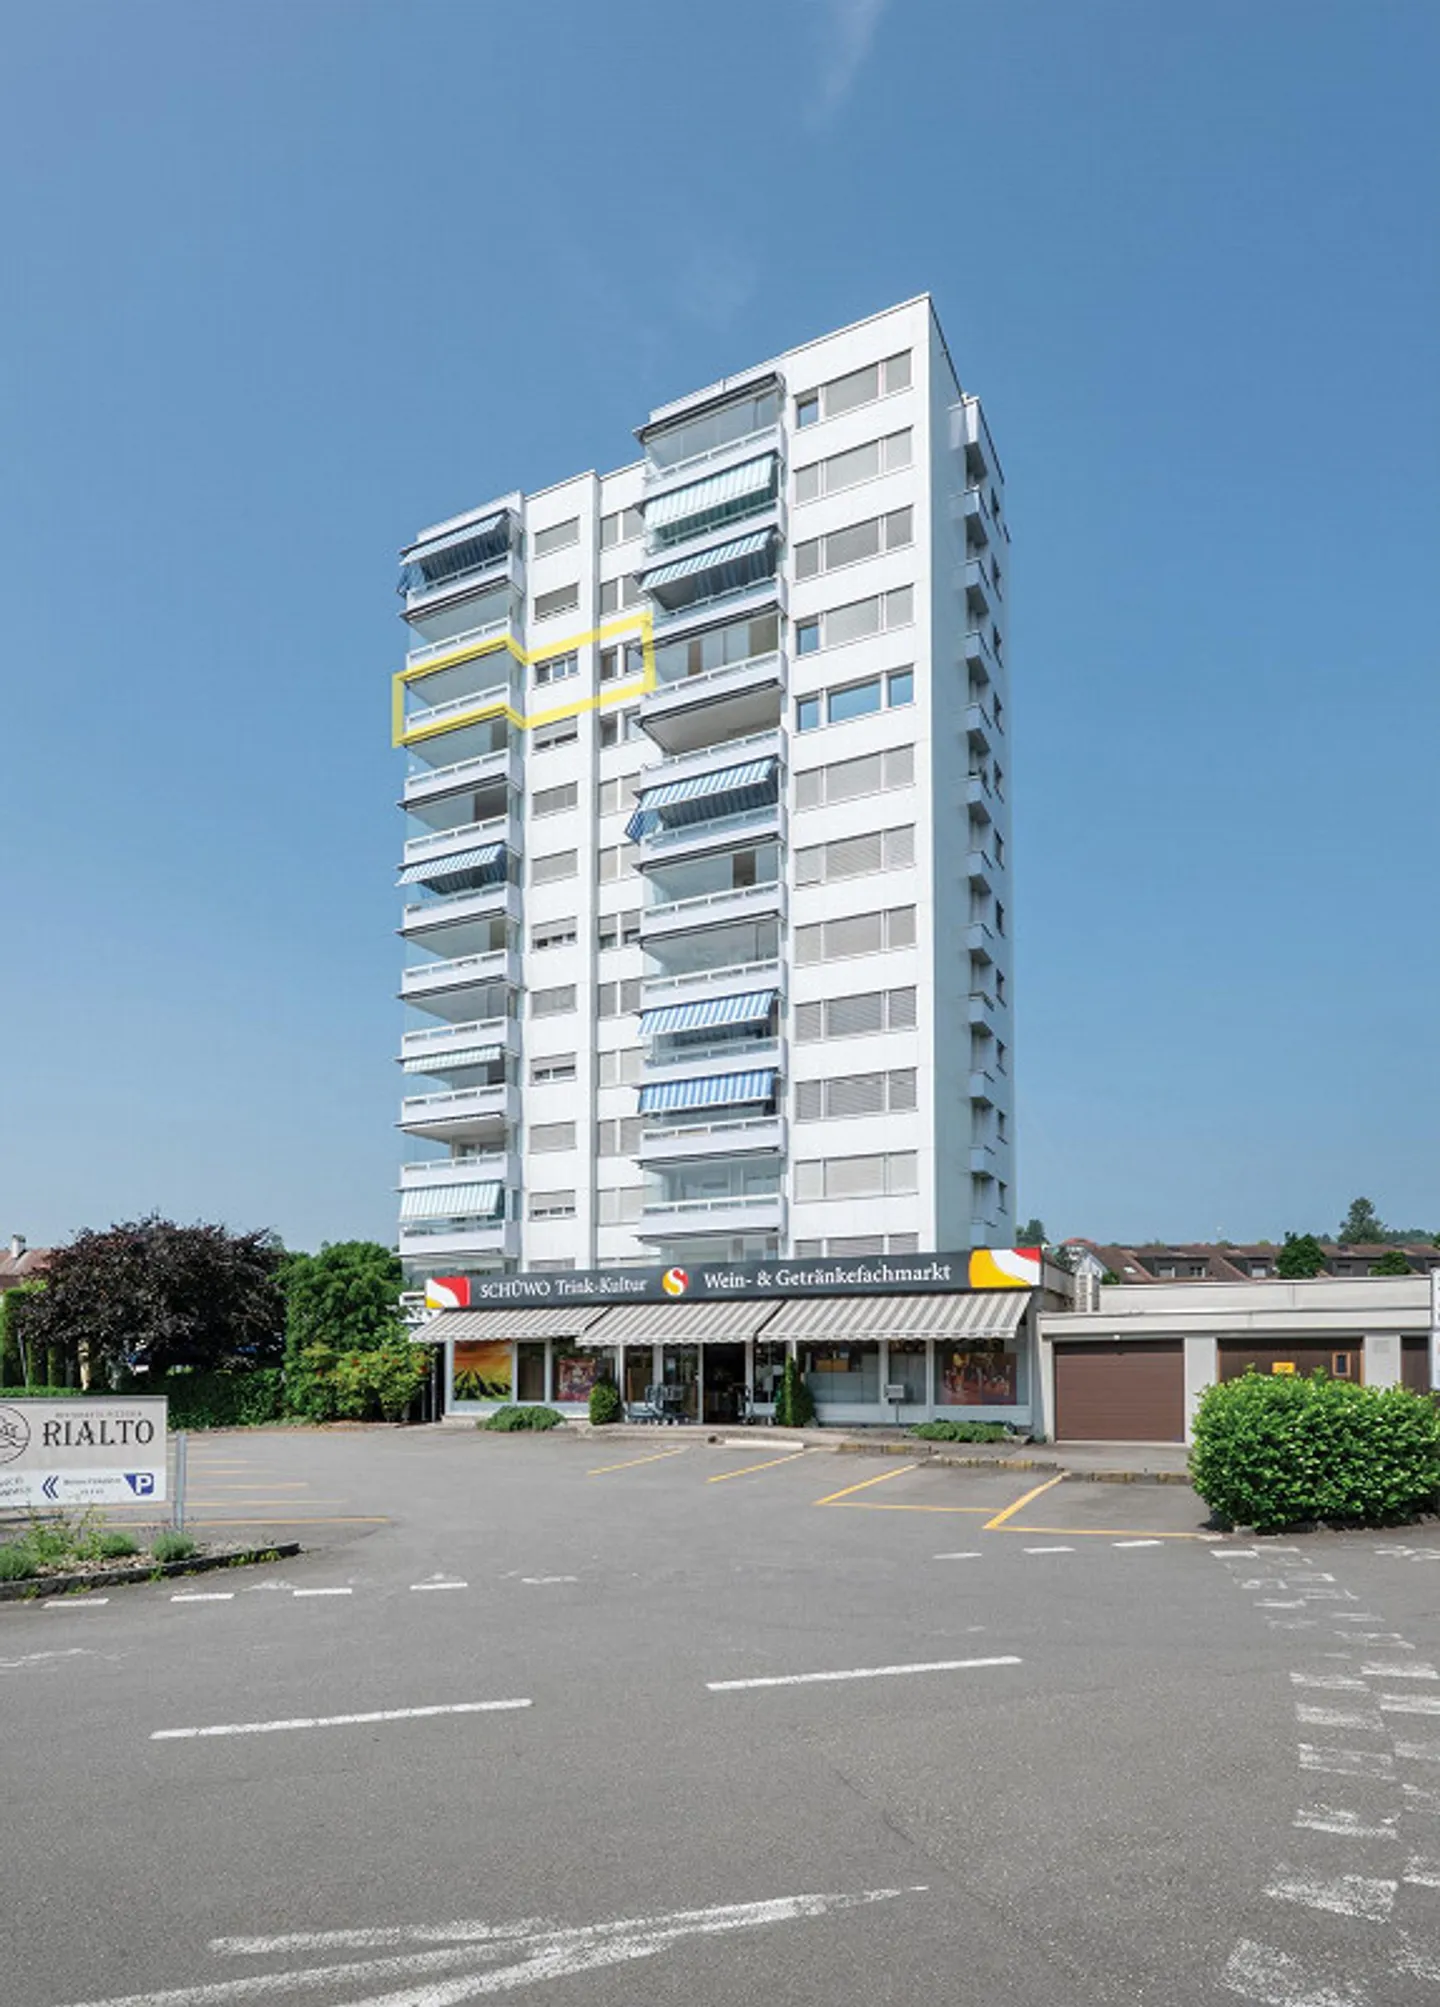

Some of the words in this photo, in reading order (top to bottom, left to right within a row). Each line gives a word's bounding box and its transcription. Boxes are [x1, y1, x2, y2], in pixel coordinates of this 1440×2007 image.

[555, 1276, 648, 1296] Trink-Kultur
[704, 1271, 752, 1289] Wein-
[757, 1270, 772, 1287] &
[775, 1261, 952, 1286] Getränkefachmarkt
[43, 1419, 155, 1447] RIALTO
